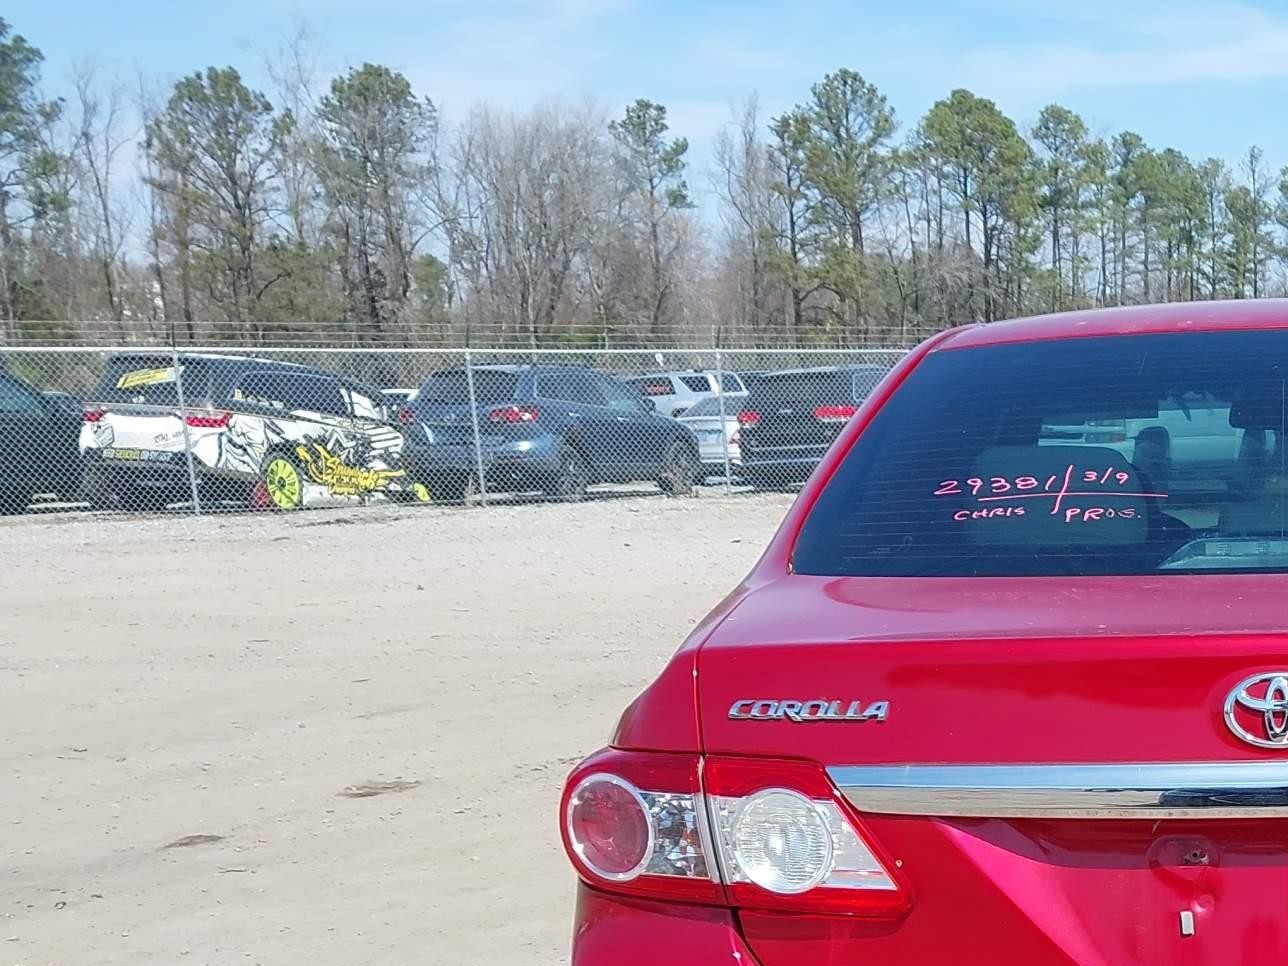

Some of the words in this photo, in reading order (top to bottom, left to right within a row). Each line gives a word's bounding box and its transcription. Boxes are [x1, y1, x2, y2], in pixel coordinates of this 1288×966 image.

[933, 475, 1056, 495] 29381
[1083, 467, 1128, 484] 3/9
[953, 506, 1025, 521] CHRIS
[728, 699, 890, 721] COROLLA
